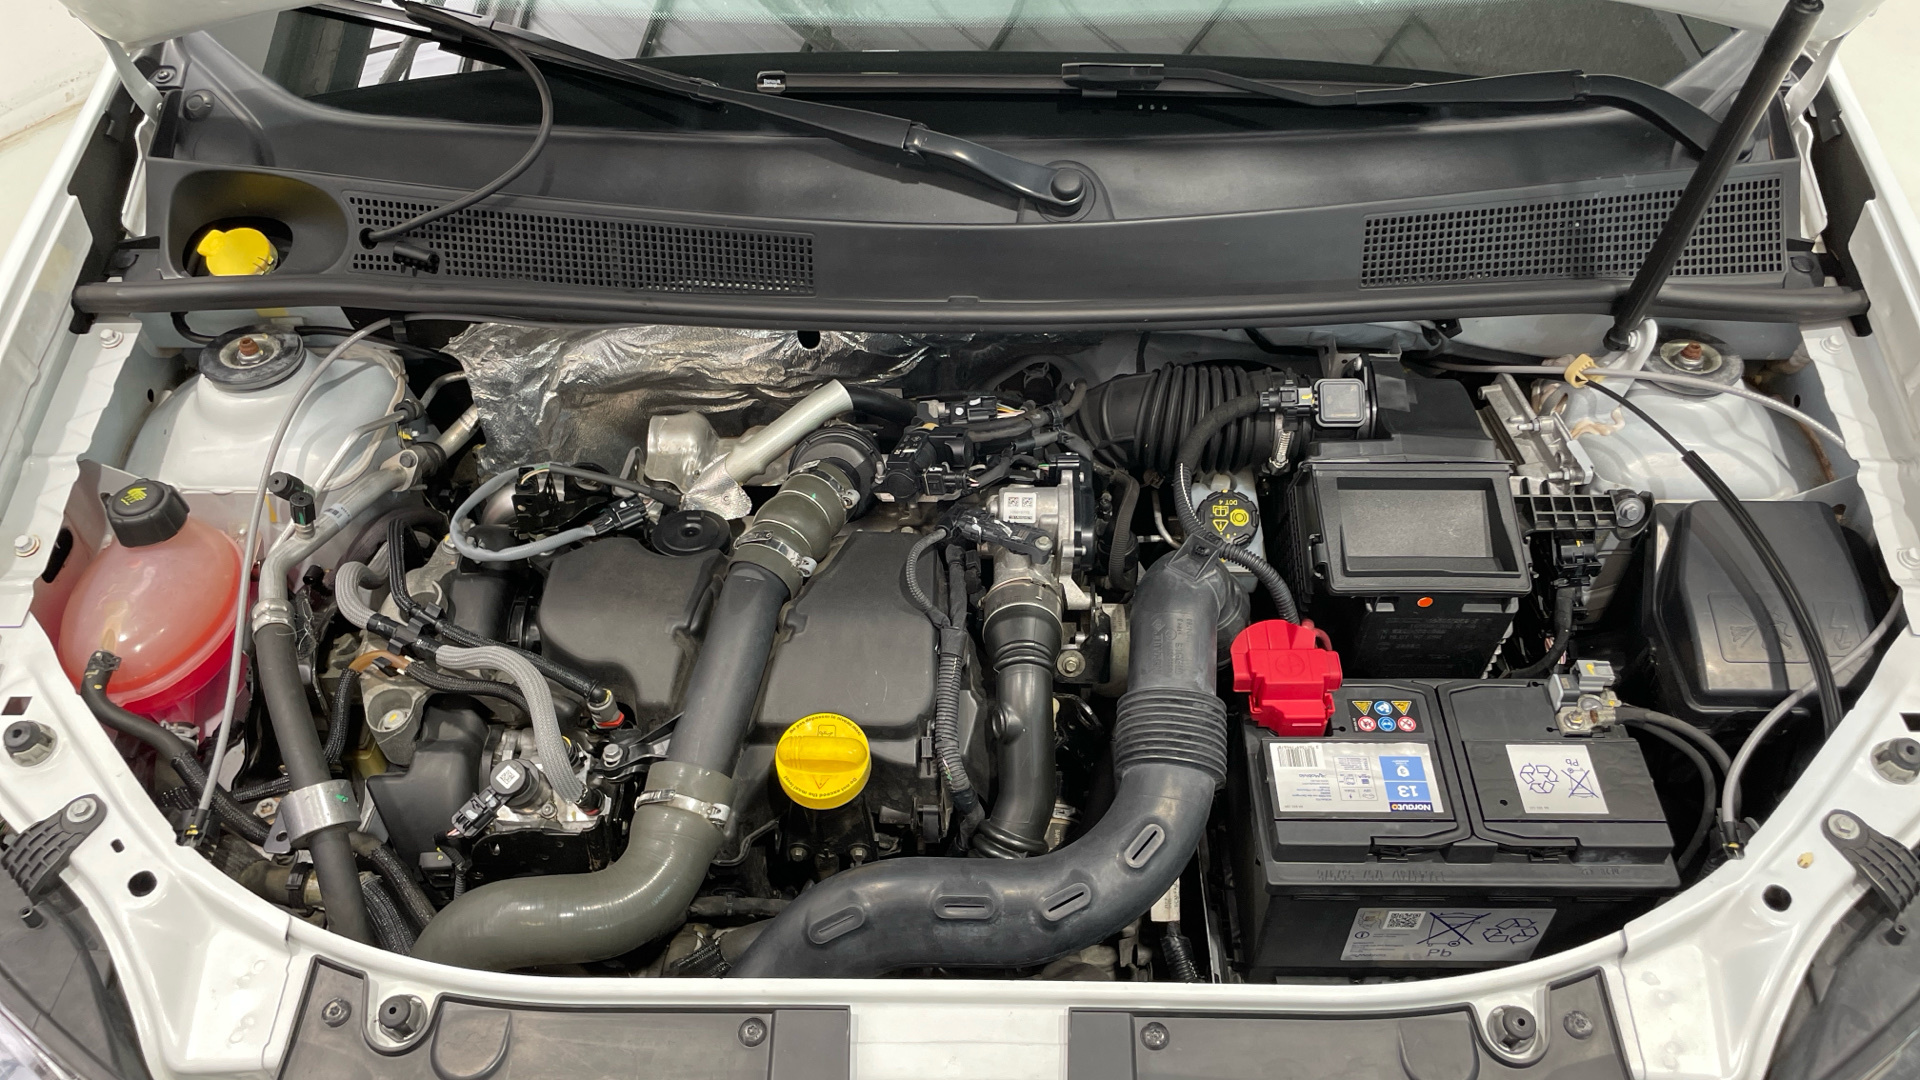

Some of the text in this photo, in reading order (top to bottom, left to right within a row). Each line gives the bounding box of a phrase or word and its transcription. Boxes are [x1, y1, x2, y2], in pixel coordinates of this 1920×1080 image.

[1565, 758, 1579, 767] Pb
[1397, 785, 1419, 798] 13
[1391, 803, 1431, 811] Norauto
[1427, 948, 1452, 957] Pb
